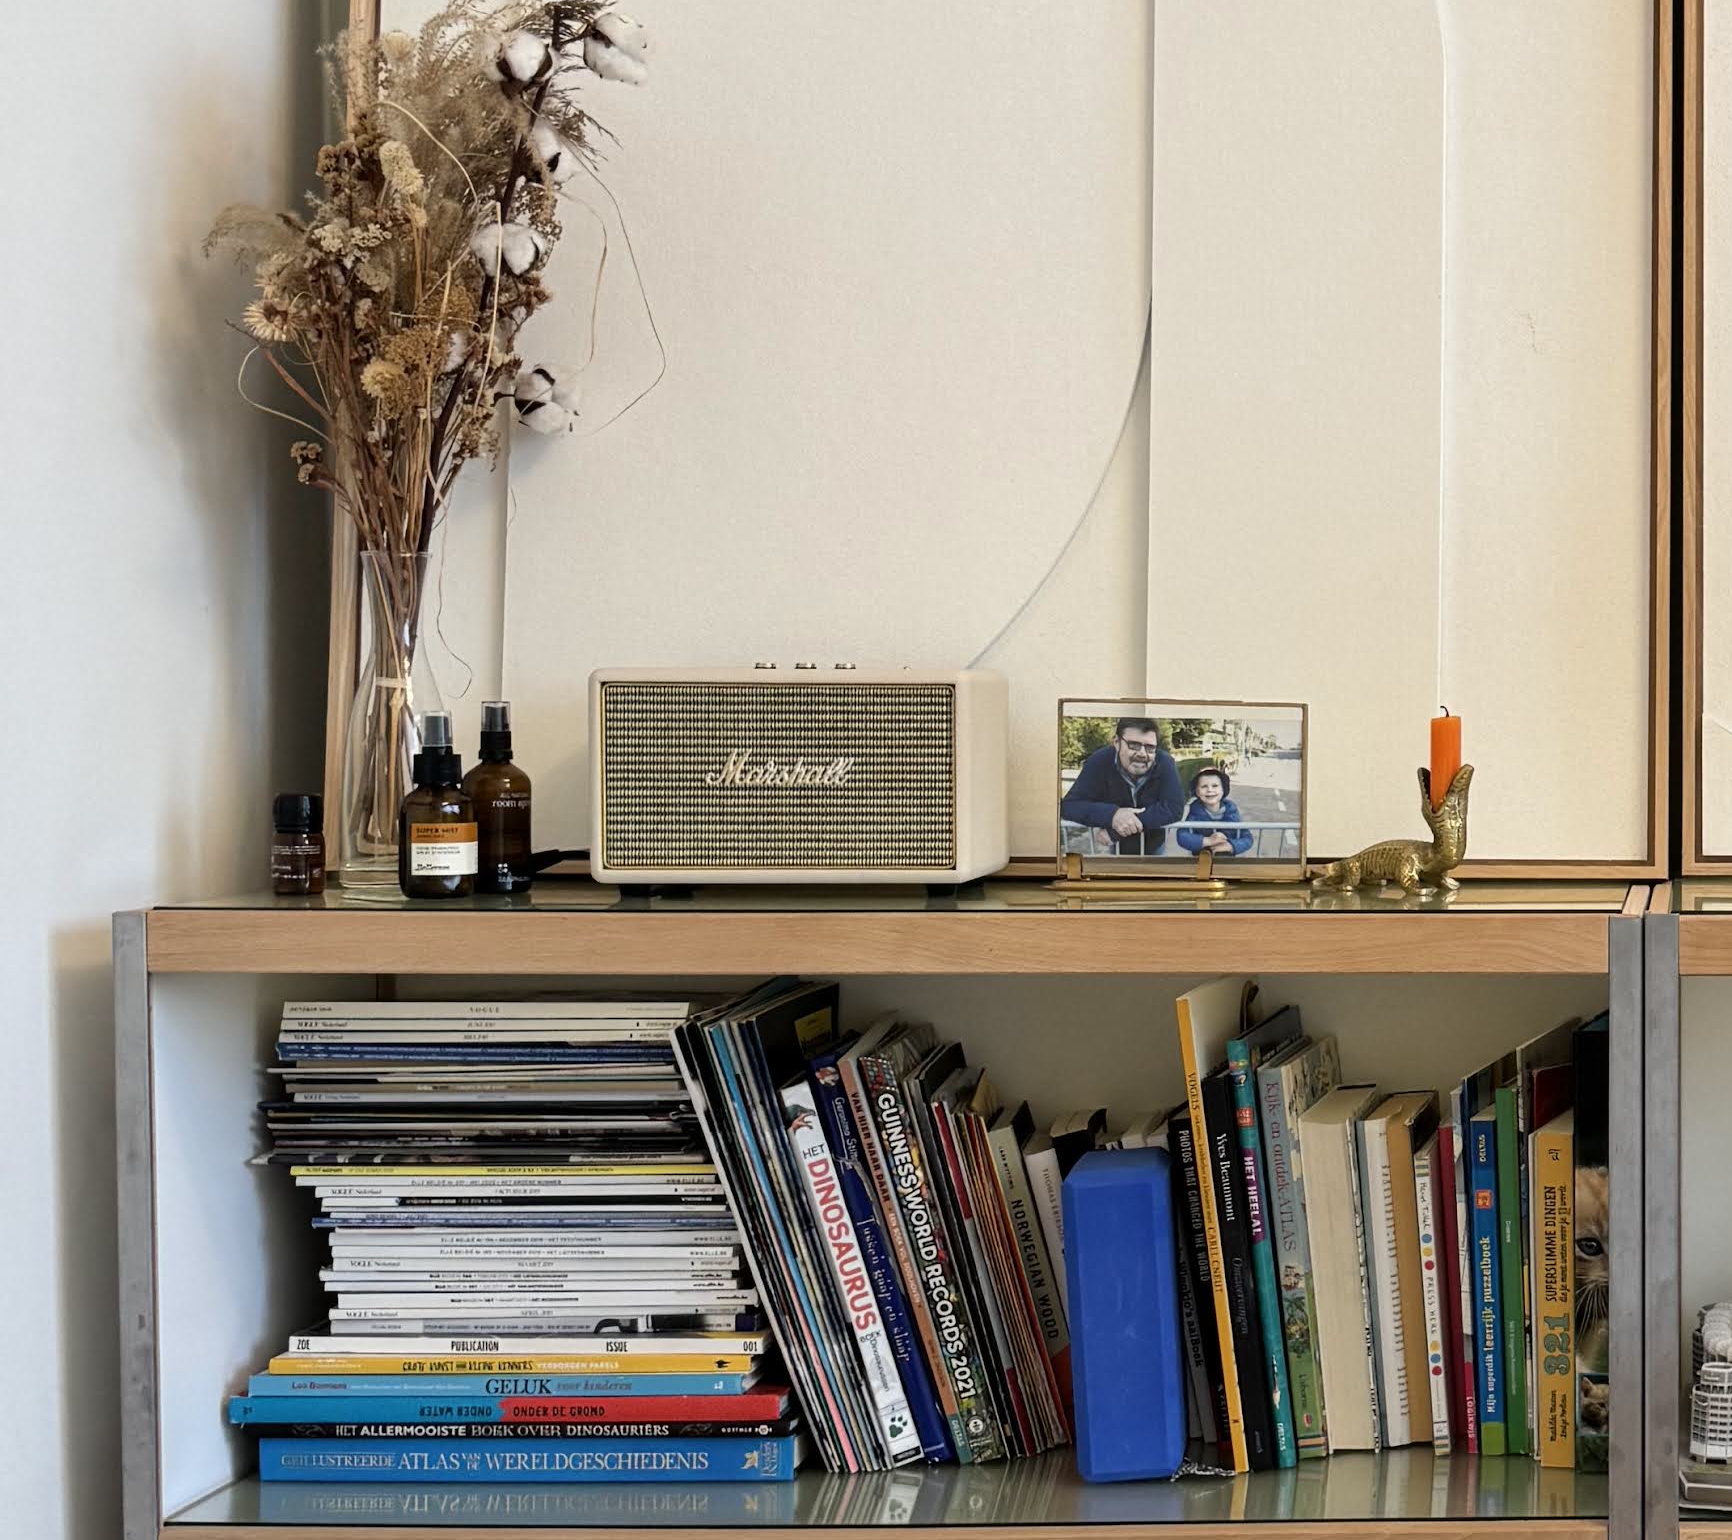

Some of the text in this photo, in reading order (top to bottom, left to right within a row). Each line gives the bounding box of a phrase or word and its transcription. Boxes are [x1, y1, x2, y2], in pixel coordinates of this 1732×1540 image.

[706, 748, 855, 787] Marshall
[492, 800, 516, 808] room
[1186, 1071, 1200, 1110] VOGELS
[832, 1095, 854, 1137] Geronimo
[1269, 1120, 1282, 1139] en
[801, 1143, 826, 1159] HET
[849, 1091, 892, 1203] VAN HIER NAAR DAAR
[1213, 1132, 1230, 1159] Yves
[1242, 1155, 1256, 1182] HET
[1039, 1167, 1057, 1204] THOMAS
[1217, 1159, 1238, 1222] Beaumont
[1177, 1128, 1211, 1282] PHOTOS THAT CHANGED THE WORLD
[1246, 1185, 1263, 1237] HEELAL
[805, 1156, 878, 1332] DINOSAURUS
[875, 1091, 977, 1401] GUINNESS WORLD RECORDS 2021
[1543, 1185, 1557, 1301] SUPERSLIMME DINGEN
[1009, 1197, 1060, 1340] NORWEGIAN WOOD
[1478, 1235, 1494, 1302] puzzelboek
[1423, 1275, 1436, 1306] PRESS
[1559, 1291, 1567, 1302] die
[1427, 1309, 1440, 1335] HERE
[1480, 1305, 1497, 1351] leerrijk
[297, 1339, 758, 1353] ZOE PUBLICATION ISSUE 001
[1542, 1312, 1570, 1375] 321
[485, 1378, 551, 1395] GELUK
[583, 1380, 633, 1392] kinderen
[1484, 1353, 1496, 1391] superdik
[418, 1406, 493, 1417] ONDER WATER
[513, 1406, 605, 1417] ONDER DE GROND
[1486, 1393, 1497, 1413] Mijn
[336, 1425, 357, 1437] HET
[360, 1425, 467, 1437] ALLERMOOISTE
[471, 1425, 515, 1437] BOEK
[517, 1425, 561, 1437] OVER
[397, 1452, 461, 1471] ATLAS
[461, 1453, 481, 1461] VAN
[467, 1461, 480, 1471] DE
[486, 1452, 709, 1470] WERELDGESCHIEDENIS
